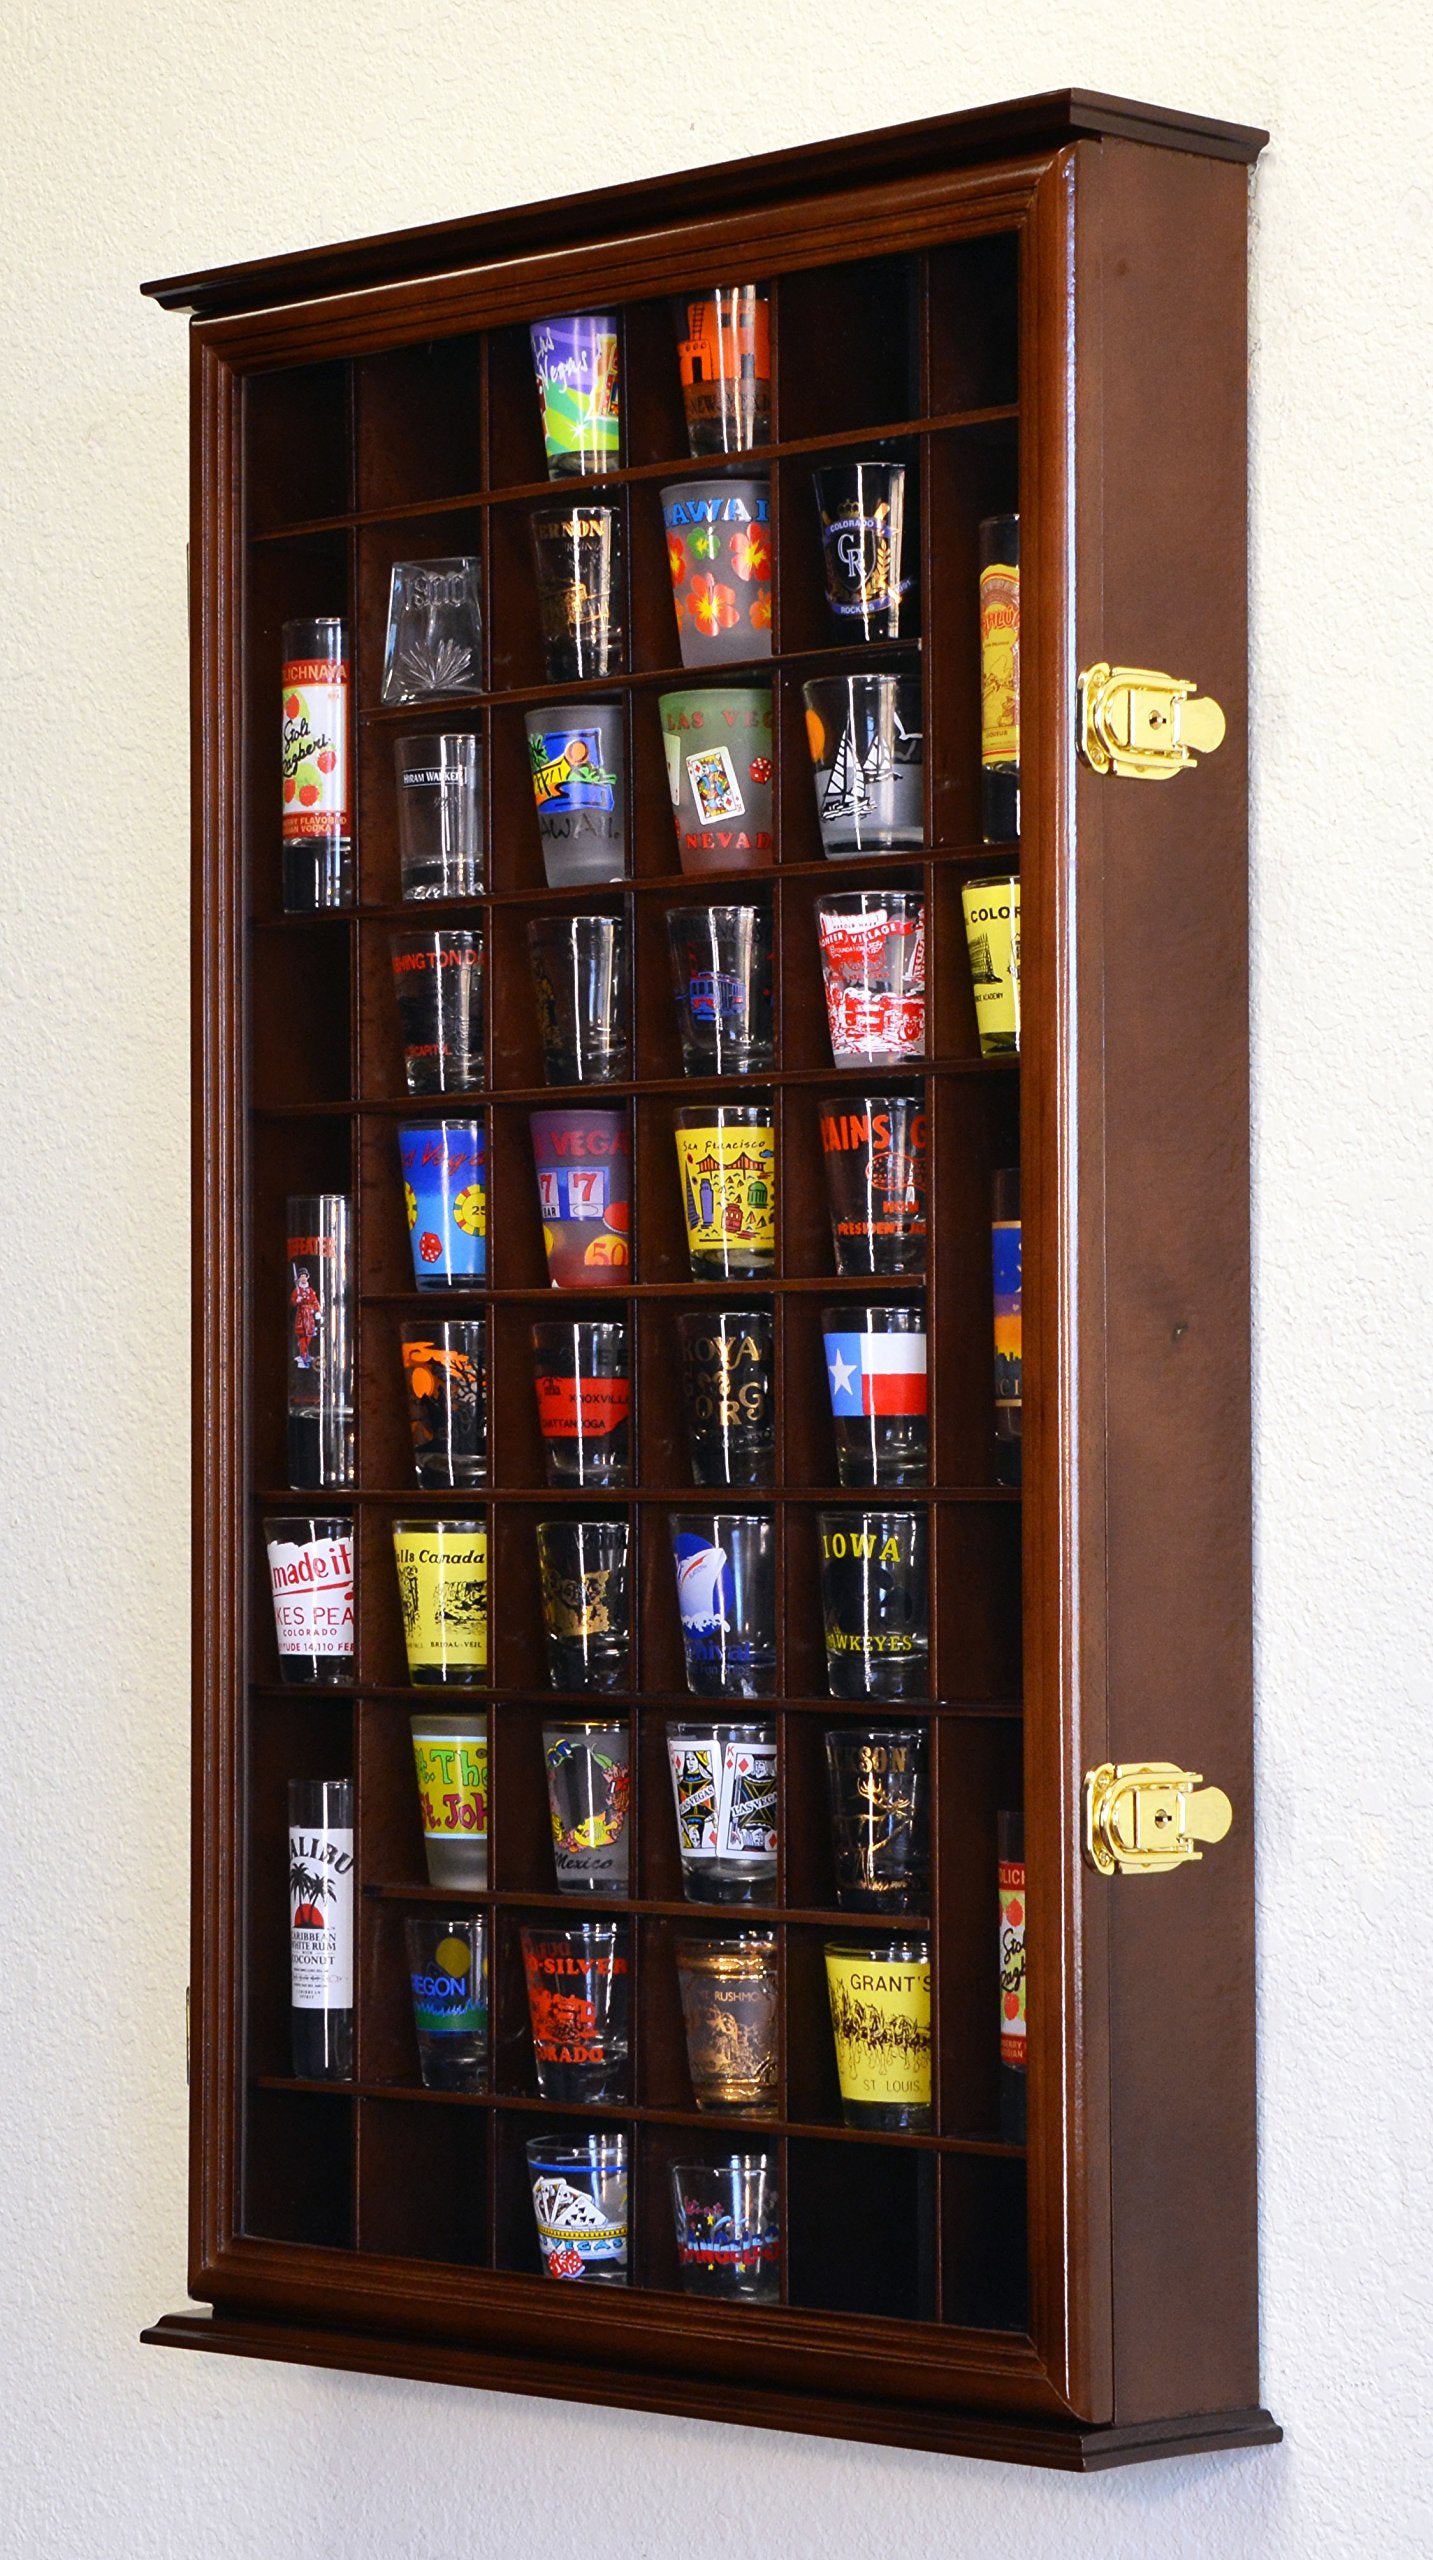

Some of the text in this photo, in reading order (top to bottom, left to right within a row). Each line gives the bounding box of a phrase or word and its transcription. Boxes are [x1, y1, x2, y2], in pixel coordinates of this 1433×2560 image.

[539, 351, 588, 393] Vegas
[840, 603, 875, 615] ROCKS
[283, 664, 347, 682] LICHNAYA
[666, 710, 705, 731] LAS
[403, 772, 425, 784] HIRAM
[300, 815, 346, 826] FLAVORD
[685, 831, 772, 850] NEVAD
[851, 923, 897, 943] VILLAGE
[413, 1043, 453, 1056] CAPITL
[573, 1172, 597, 1202] 7
[569, 1393, 628, 1405] KOXVILL
[419, 1549, 485, 1564] Canada
[823, 1532, 901, 1563] IOWA
[272, 1543, 352, 1589] made it
[283, 1628, 338, 1637] COLORADO
[727, 1745, 735, 1756] K
[690, 1786, 714, 1807] VEGAS
[733, 1803, 753, 1816] LAS
[555, 1852, 613, 1870] Mexico
[850, 1973, 931, 1993] GRANT'S
